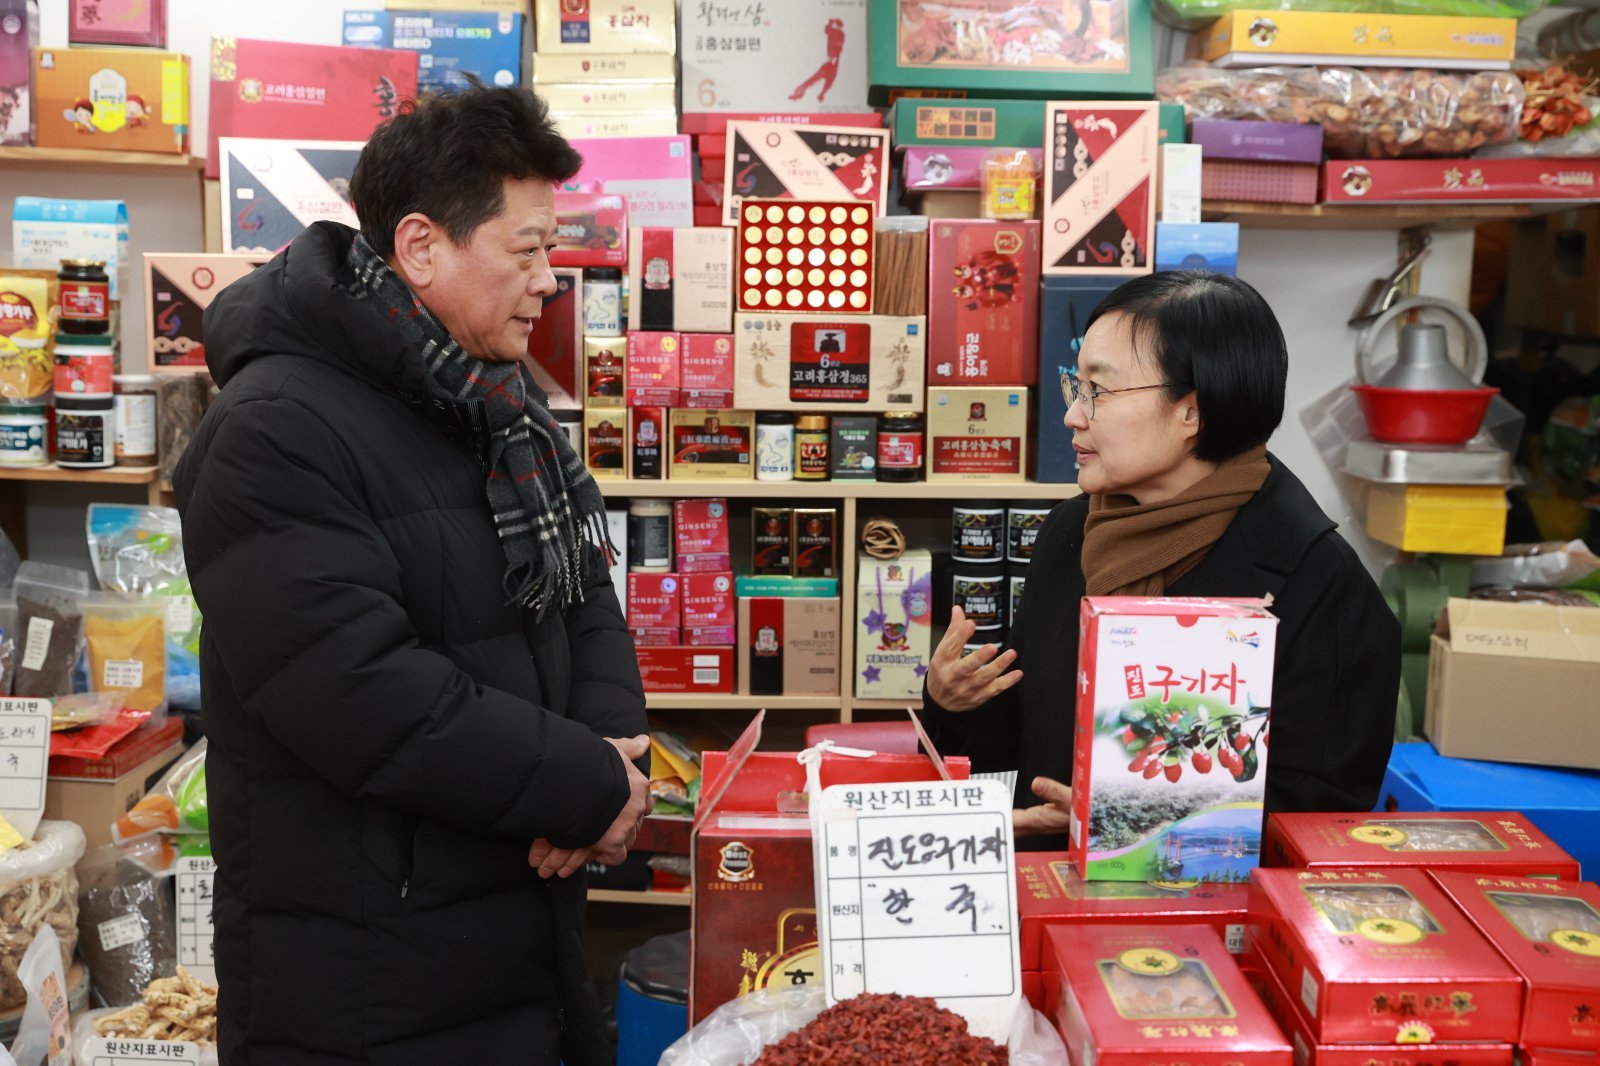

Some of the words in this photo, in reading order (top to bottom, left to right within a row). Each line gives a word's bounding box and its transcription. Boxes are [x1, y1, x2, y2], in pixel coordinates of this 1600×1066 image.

[684, 357, 725, 365] GINSENG
[965, 333, 979, 378] 홍이장군
[792, 369, 868, 385] 고려홍삼정365
[678, 522, 718, 531] GINSENG
[631, 597, 670, 605] GINSENG
[684, 596, 724, 604] GINSENG
[1126, 665, 1144, 699] 진도
[1147, 661, 1247, 706] 구기자
[0, 701, 39, 713] 표시판
[843, 786, 985, 811] 원산지표시판
[725, 849, 748, 859] Best
[829, 845, 839, 857] 품
[848, 845, 857, 857] 명
[831, 903, 860, 917] 원산지
[884, 887, 915, 924] 한
[834, 963, 845, 976] 가
[852, 962, 863, 975] 격
[105, 1041, 185, 1057] 원산지표시판
